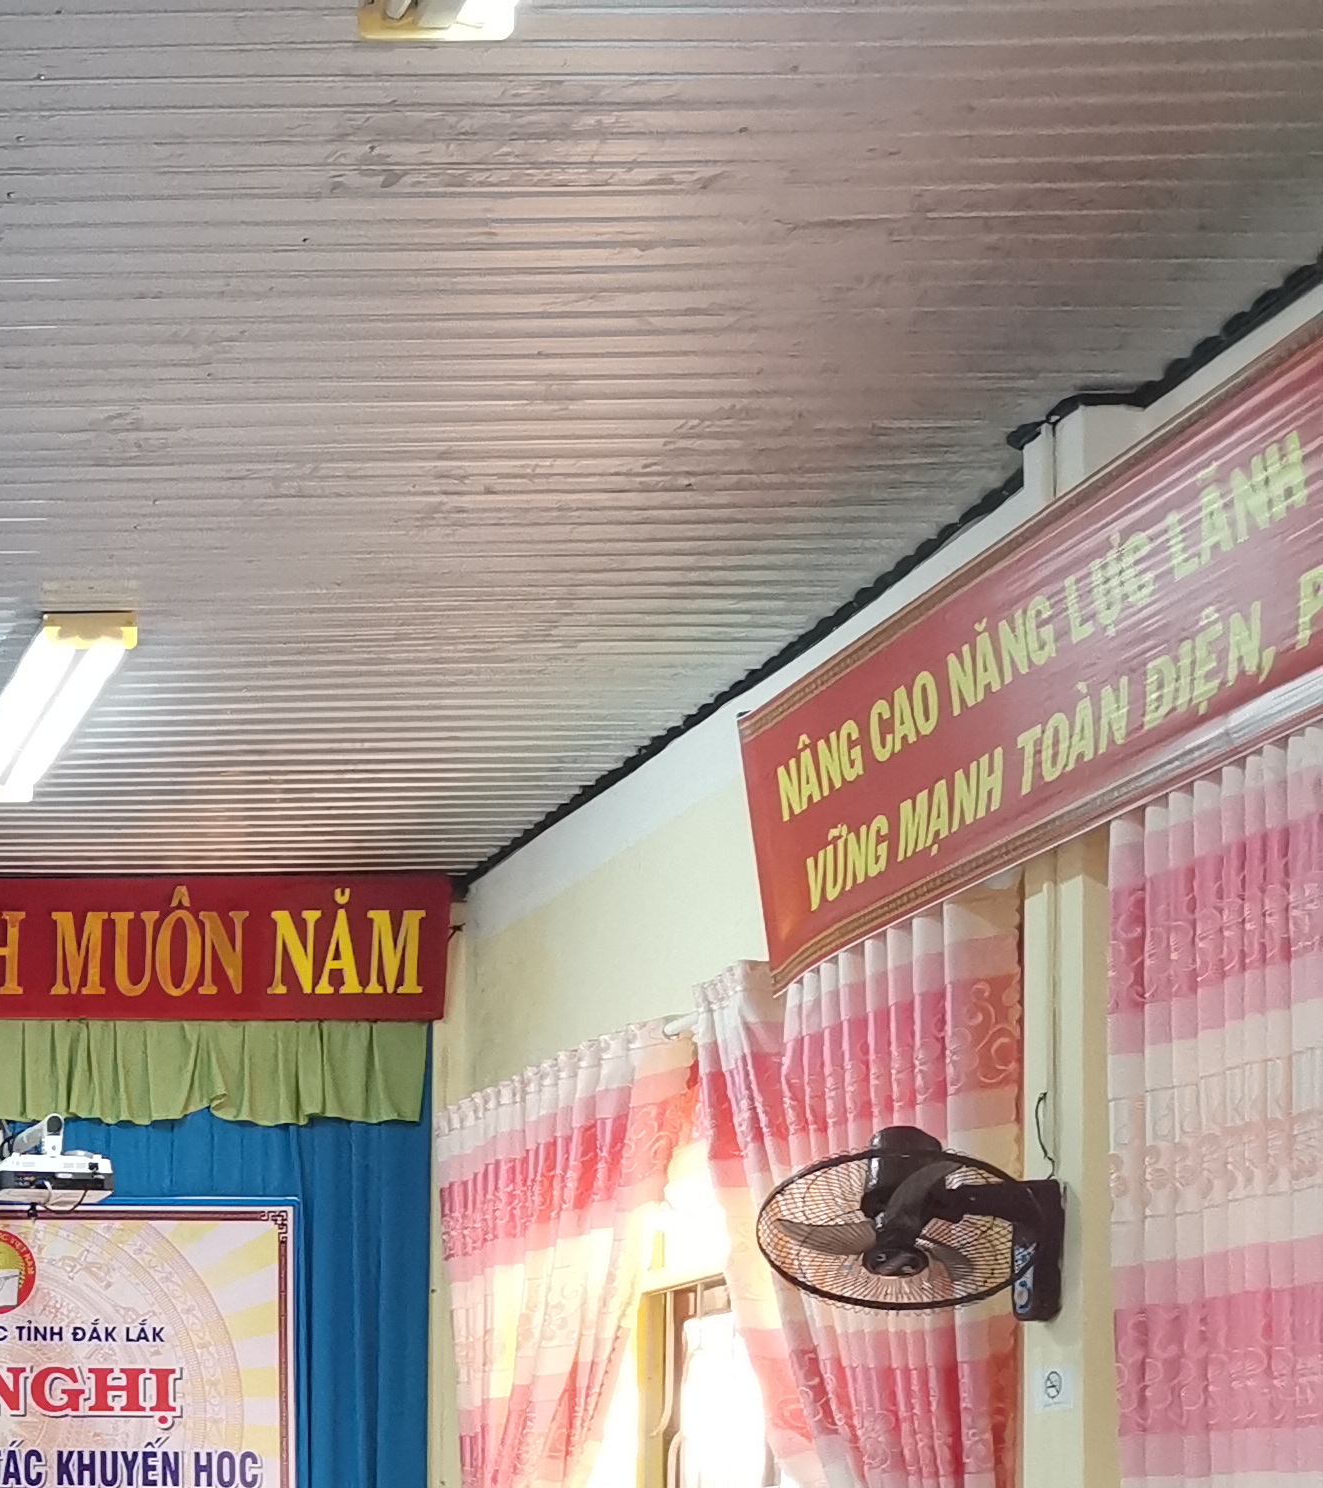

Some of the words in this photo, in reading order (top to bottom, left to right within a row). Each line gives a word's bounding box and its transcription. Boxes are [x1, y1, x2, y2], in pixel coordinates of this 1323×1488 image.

[777, 720, 864, 822] NÂNG
[869, 670, 939, 762] CAO
[947, 596, 1056, 716] NĂNG
[806, 814, 889, 912] VỮNG
[897, 746, 1003, 862] MẠNH
[1016, 676, 1130, 798] TOÀN
[52, 885, 248, 997] MUÔN
[267, 887, 426, 996] NĂM
[15, 1320, 63, 1342] TỈNH
[71, 1318, 117, 1342] ĐẮK
[126, 1318, 165, 1342] LẮK
[57, 1437, 180, 1487] KHUYẾN
